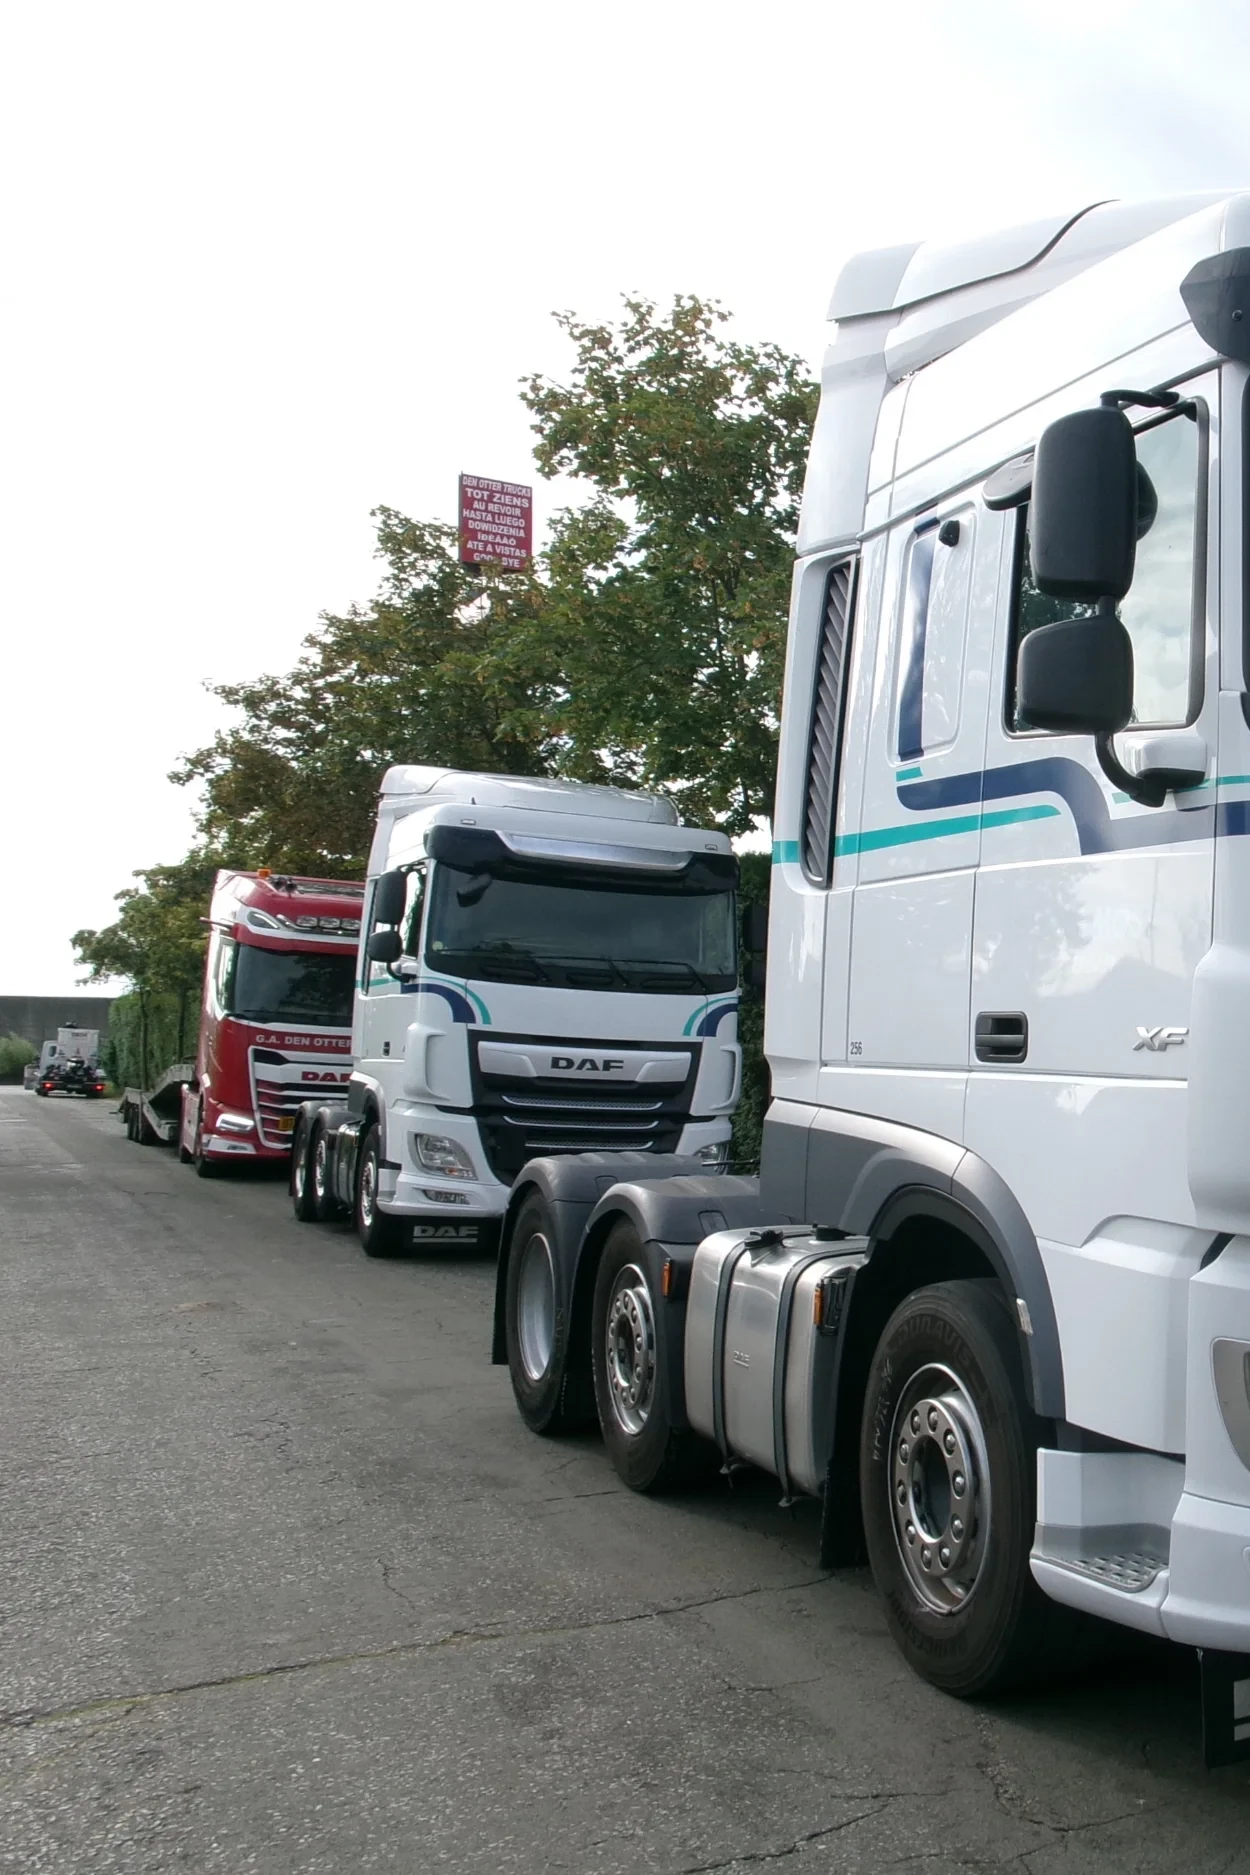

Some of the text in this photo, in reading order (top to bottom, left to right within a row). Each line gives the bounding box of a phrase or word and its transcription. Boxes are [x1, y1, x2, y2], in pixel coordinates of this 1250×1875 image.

[463, 476, 531, 497] DEN OTTER TRUCKS
[465, 488, 529, 508] TOT ZIENS
[473, 500, 521, 517] AU REVOIR
[463, 508, 525, 528] HASTA LUEGO
[468, 520, 525, 537] DOWIDZENIA
[467, 540, 526, 558] ATE A VISTAS
[256, 1034, 280, 1044] G.A.
[284, 1036, 310, 1046] DEN
[1132, 1026, 1190, 1052] XF
[850, 1041, 863, 1056] 256
[550, 1056, 625, 1072] DAF
[413, 1225, 479, 1237] DAF
